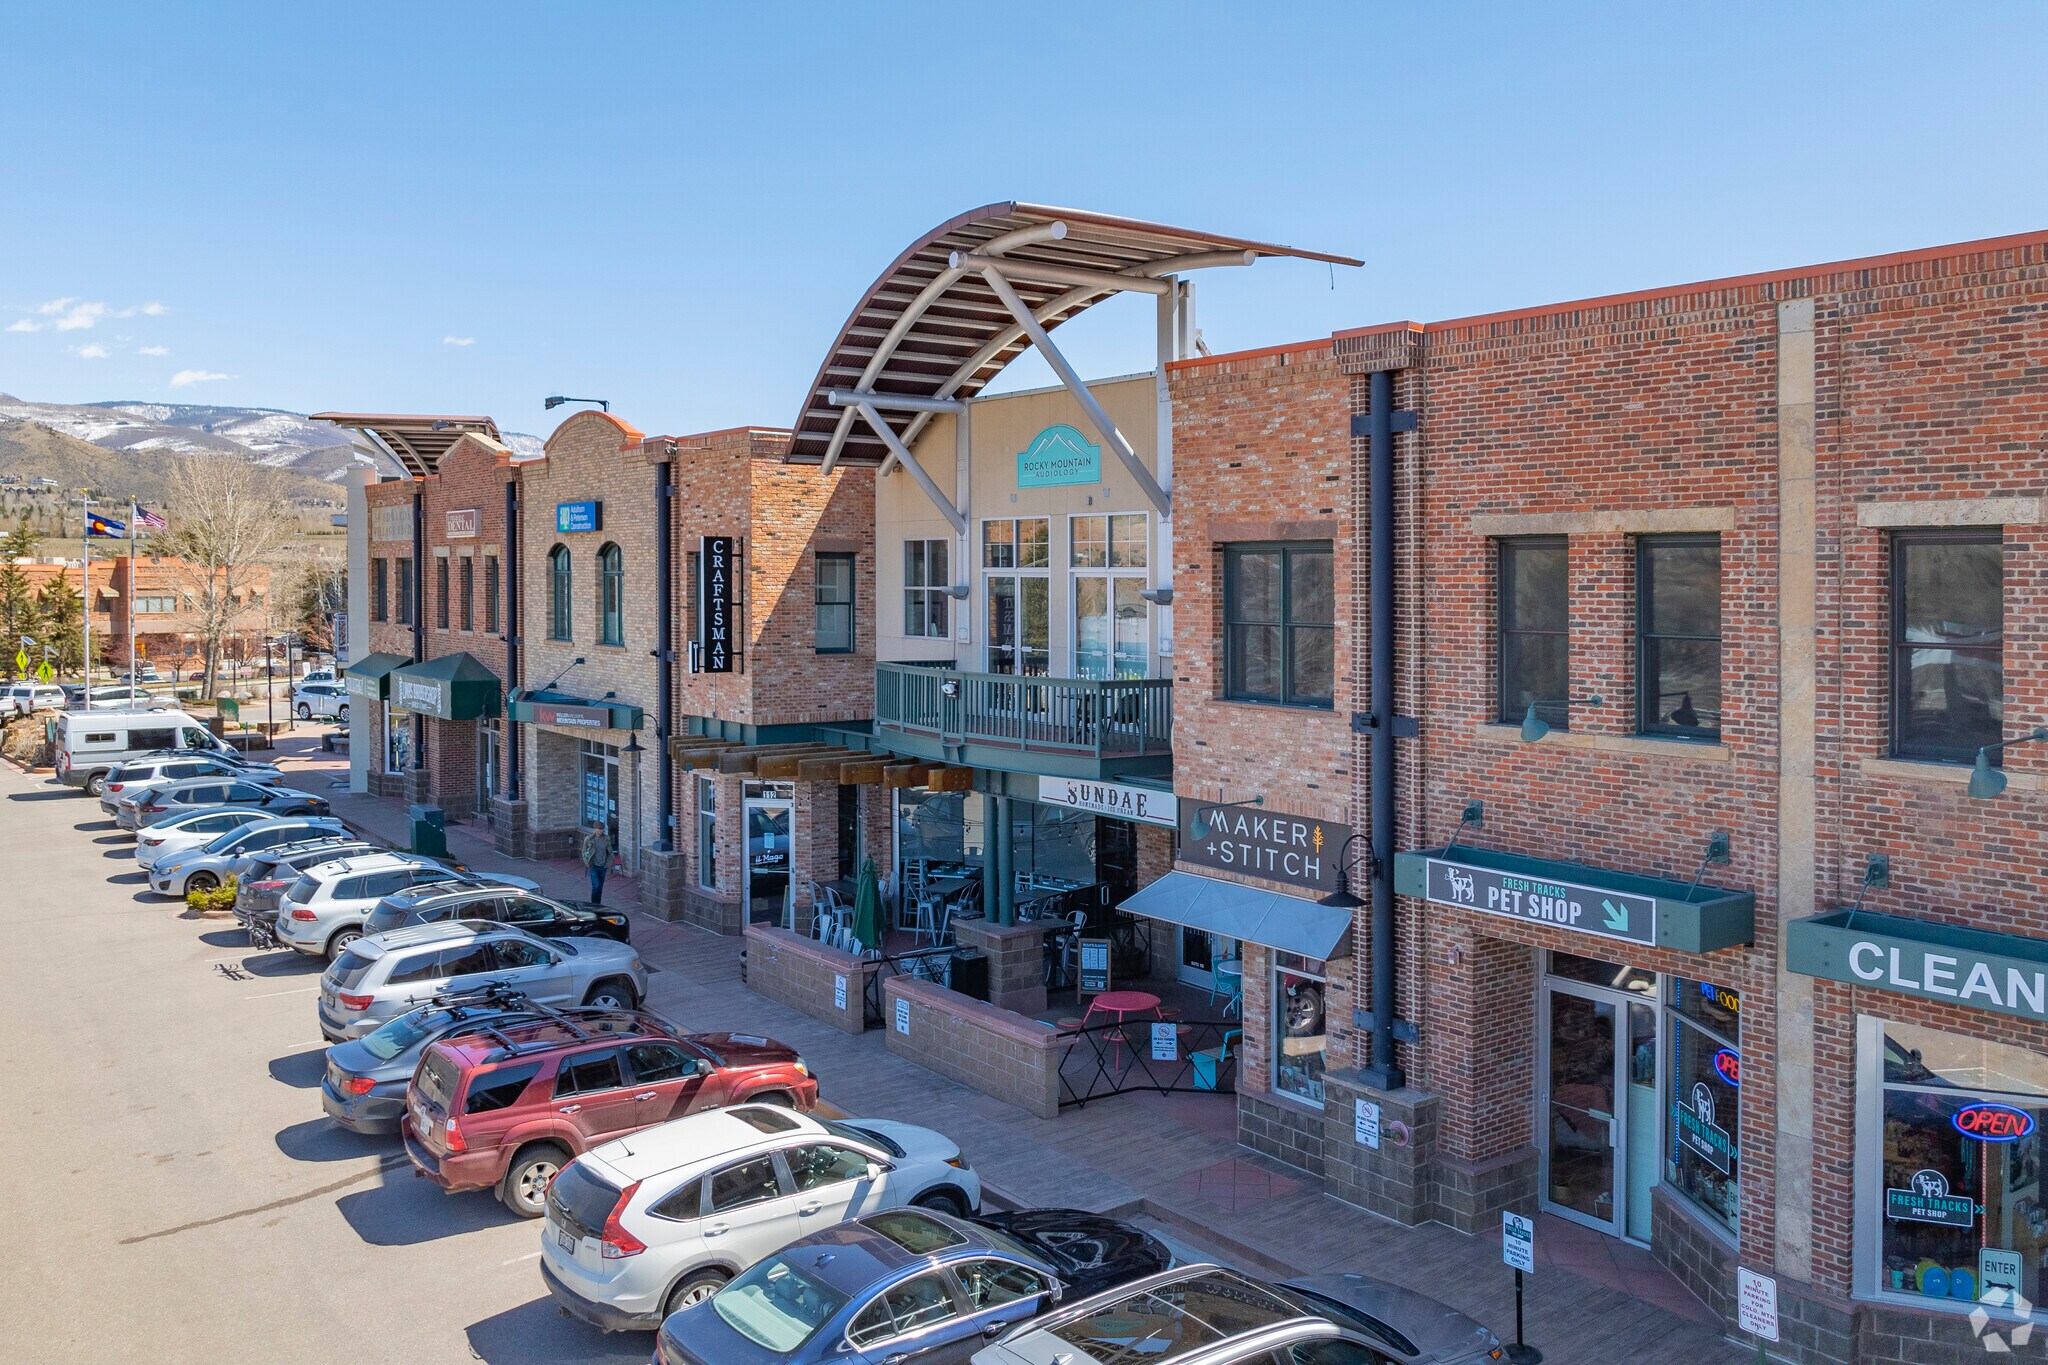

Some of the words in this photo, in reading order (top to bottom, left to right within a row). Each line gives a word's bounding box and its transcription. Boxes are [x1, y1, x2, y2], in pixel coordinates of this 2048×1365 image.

[1024, 461, 1049, 472] ROCKY
[1051, 457, 1091, 469] MOUNTAIN
[1035, 468, 1079, 478] AUDIOLOGY
[448, 519, 474, 531] DENTAL
[712, 540, 726, 669] CRAFTSMAN
[577, 719, 601, 727] PROPERTIES
[1067, 781, 1147, 818] SUNDAE
[1078, 800, 1104, 811] HOMEMADE
[1107, 805, 1116, 813] ICE
[1117, 807, 1134, 816] CREAM
[1209, 810, 1307, 848] MAKER
[1207, 840, 1320, 880] +STITCH
[1502, 877, 1529, 893] FRESH
[1532, 882, 1566, 899] TRACKS
[1488, 886, 1524, 913] PET
[1528, 894, 1582, 925] SHOP
[1849, 941, 2045, 1014] CLEAN
[1701, 981, 1715, 1001] PET
[1717, 1053, 1739, 1080] OPE
[1958, 1110, 2027, 1136] OPEN
[1680, 1109, 1700, 1135] FRESH
[1701, 1122, 1727, 1153] TRACKS
[1692, 1133, 1701, 1147] PET
[1701, 1139, 1714, 1155] SHOP
[1891, 1193, 1924, 1207] FRESH
[1928, 1198, 1968, 1213] TRACKS
[1912, 1207, 1926, 1216] PET
[1927, 1209, 1947, 1218] SHOP
[1506, 1249, 1530, 1262] PARKING
[1507, 1243, 1528, 1255] MINUTE
[1511, 1256, 1525, 1266] ONLY
[1984, 1260, 2016, 1275] ENTER
[1745, 1284, 1769, 1297] MINUTE
[1753, 1279, 1762, 1287] 10
[1743, 1290, 1771, 1304] PARKING
[1751, 1300, 1764, 1309] FOR
[1742, 1310, 1775, 1326] CLEANERS
[1761, 1311, 1775, 1320] MTN
[1750, 1320, 1766, 1330] ONLY
